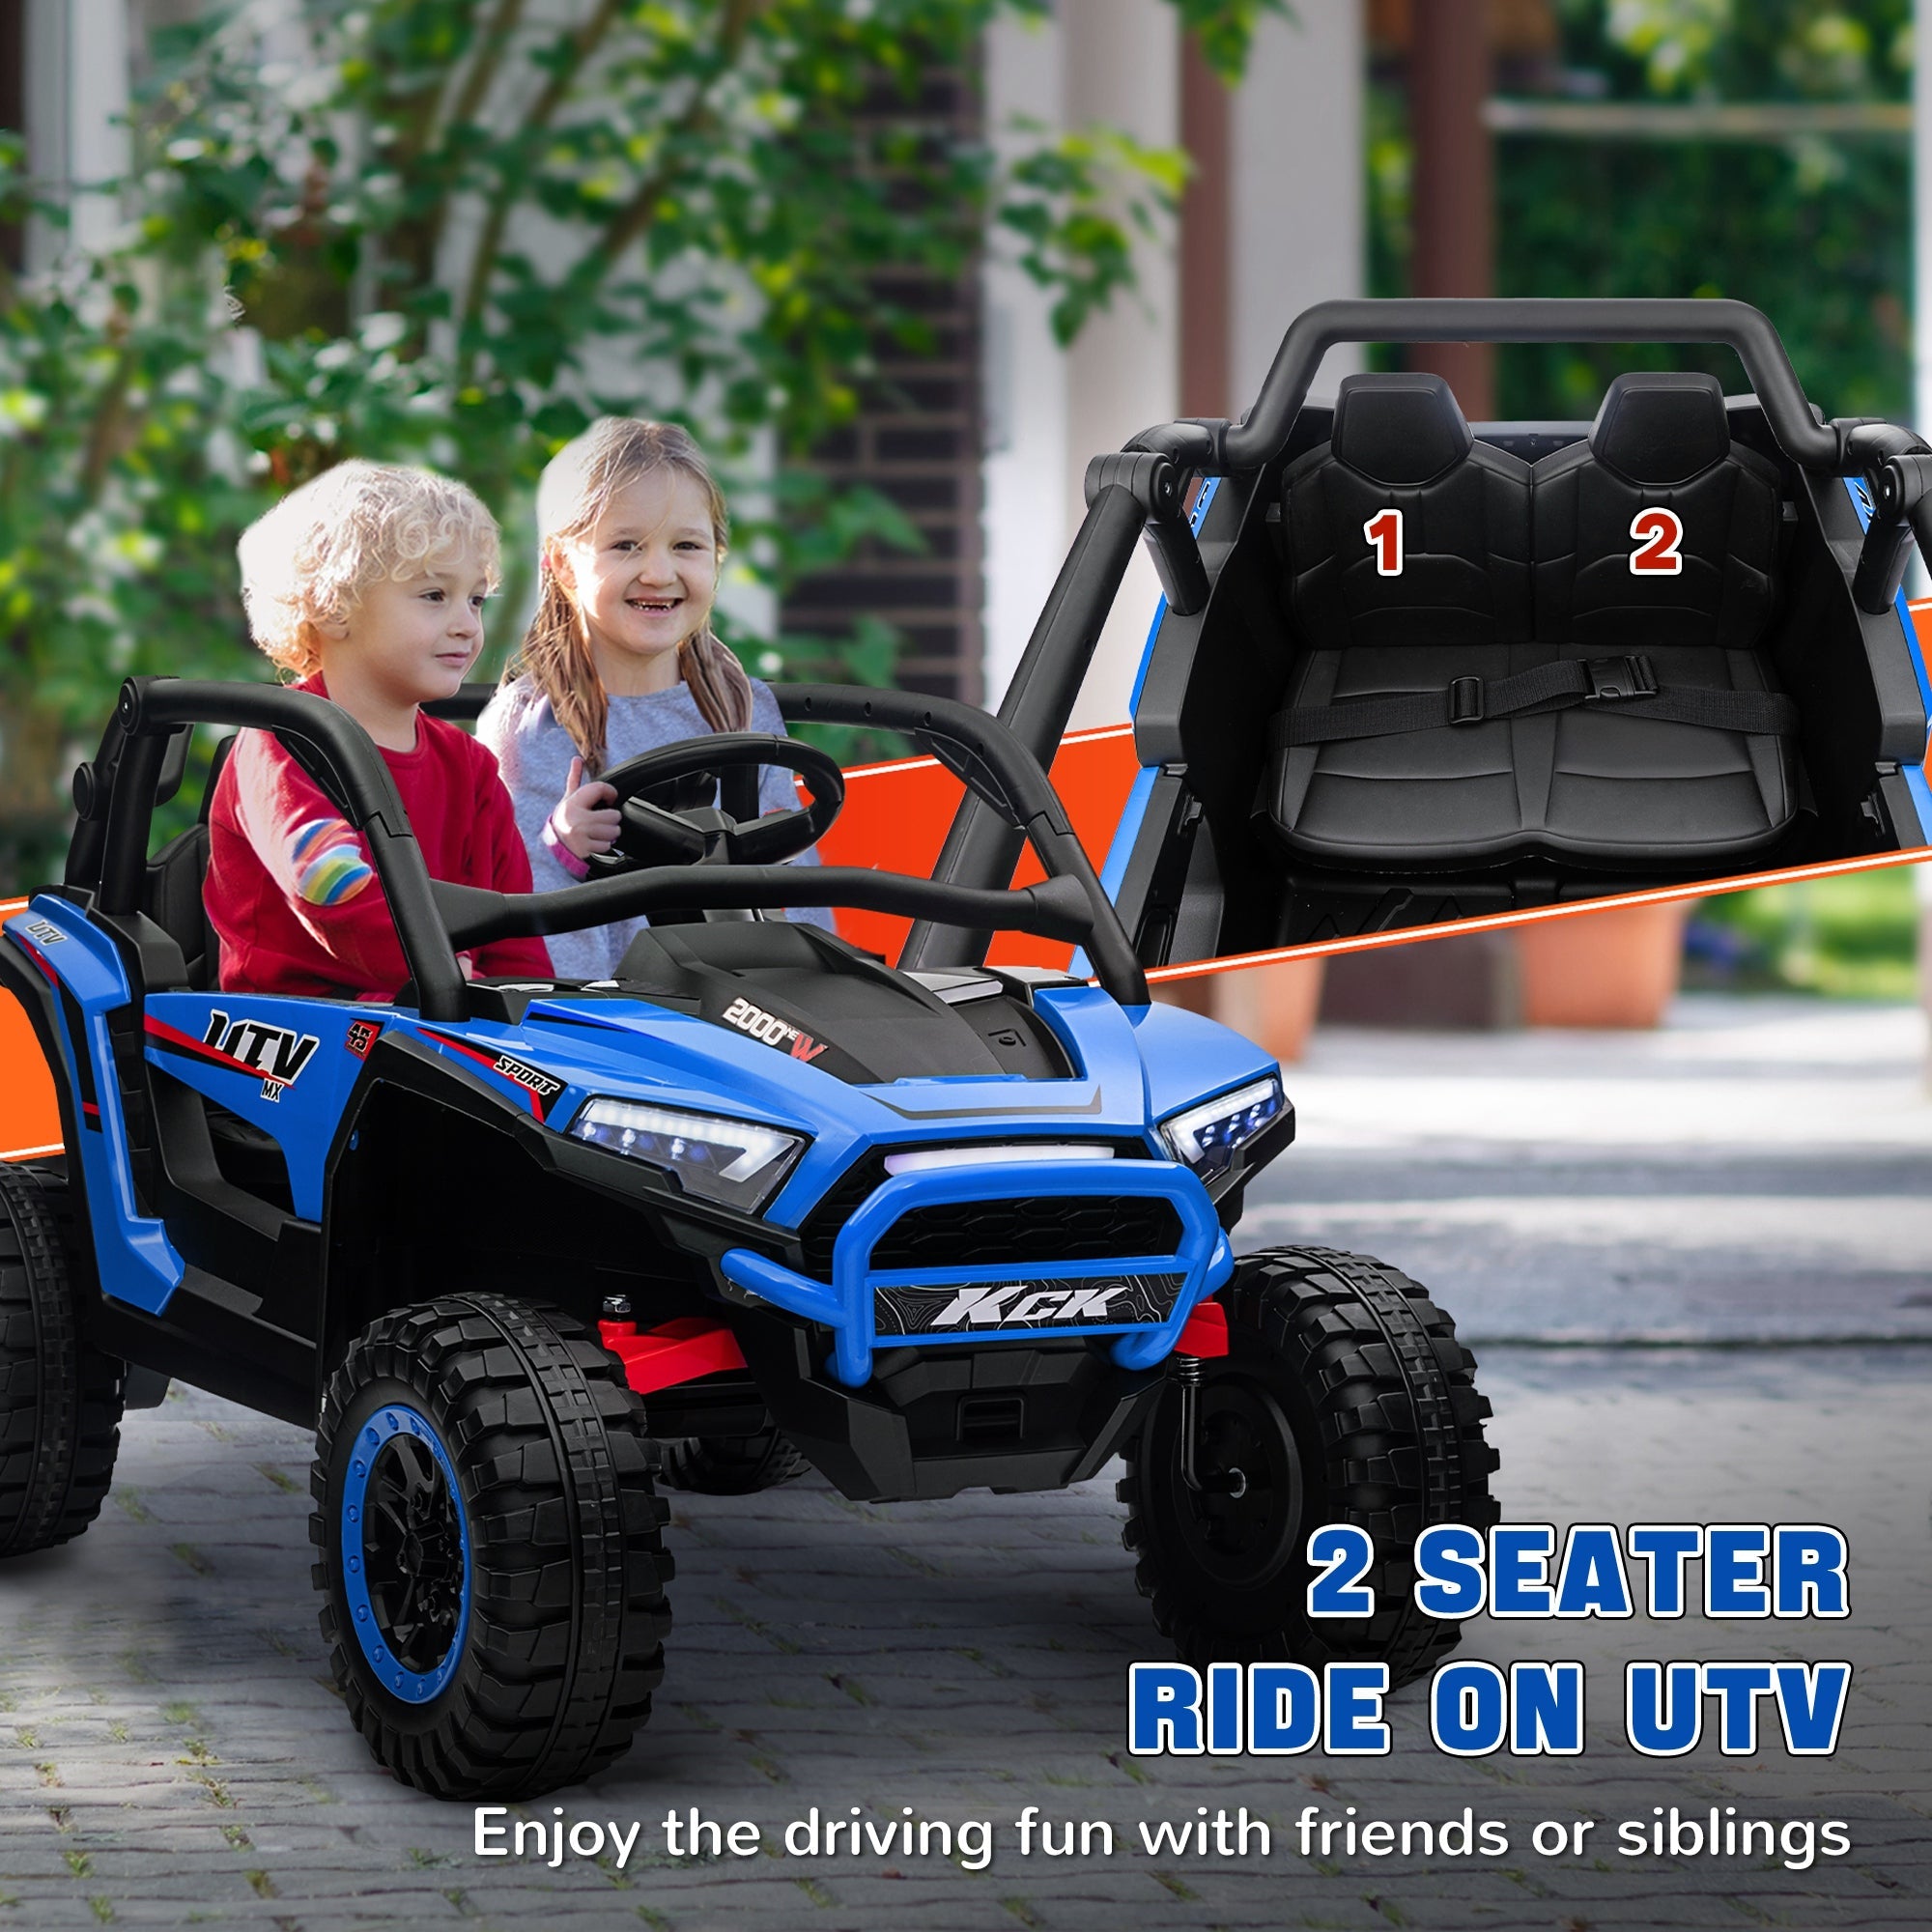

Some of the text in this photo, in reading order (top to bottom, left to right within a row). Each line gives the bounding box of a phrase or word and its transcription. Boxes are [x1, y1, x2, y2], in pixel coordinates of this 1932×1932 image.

[25, 919, 68, 946] UTV
[493, 1055, 560, 1095] SPORT
[260, 1078, 285, 1103] MX
